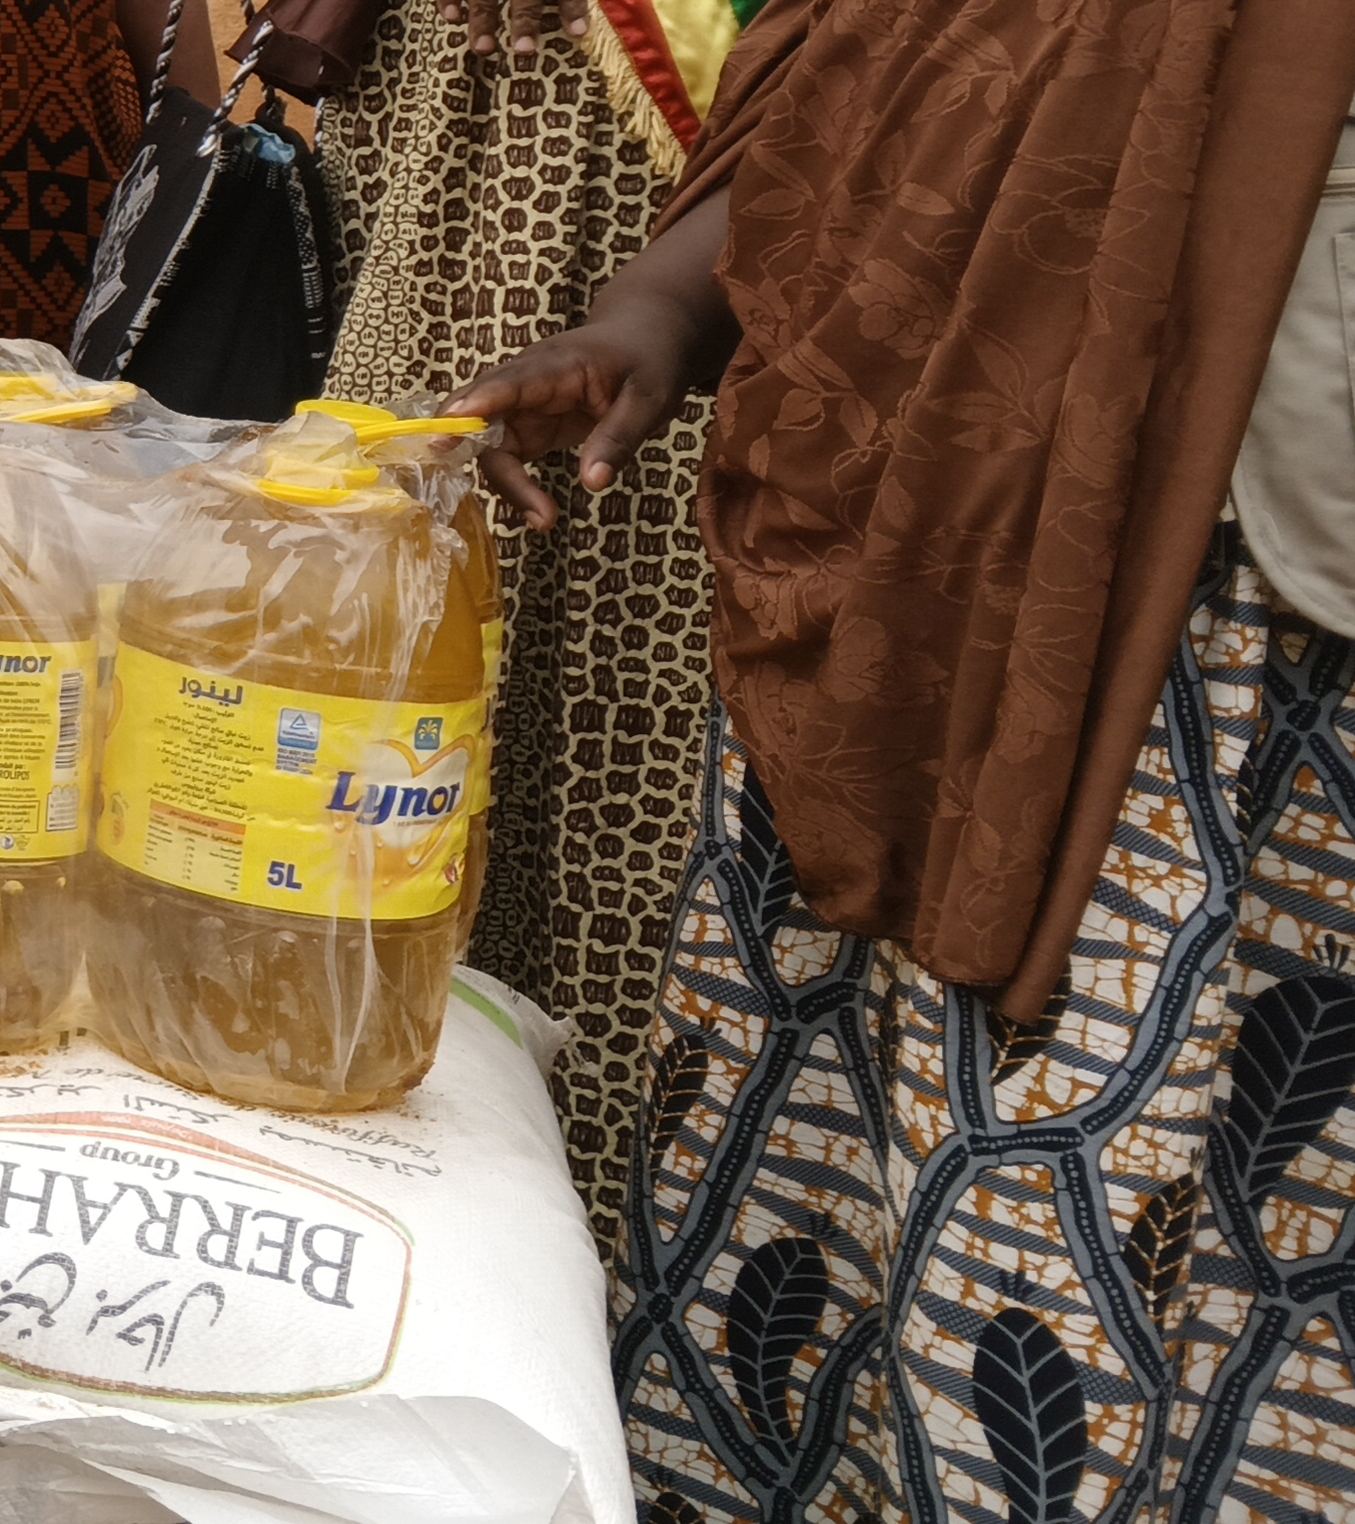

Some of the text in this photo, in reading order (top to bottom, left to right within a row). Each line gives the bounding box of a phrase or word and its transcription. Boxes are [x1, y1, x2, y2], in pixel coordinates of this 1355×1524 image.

[178, 676, 244, 708] لينور
[325, 771, 461, 826] Lynor
[266, 860, 303, 891] 5L
[78, 1140, 181, 1181] Group
[84, 1278, 226, 1374] برحال
